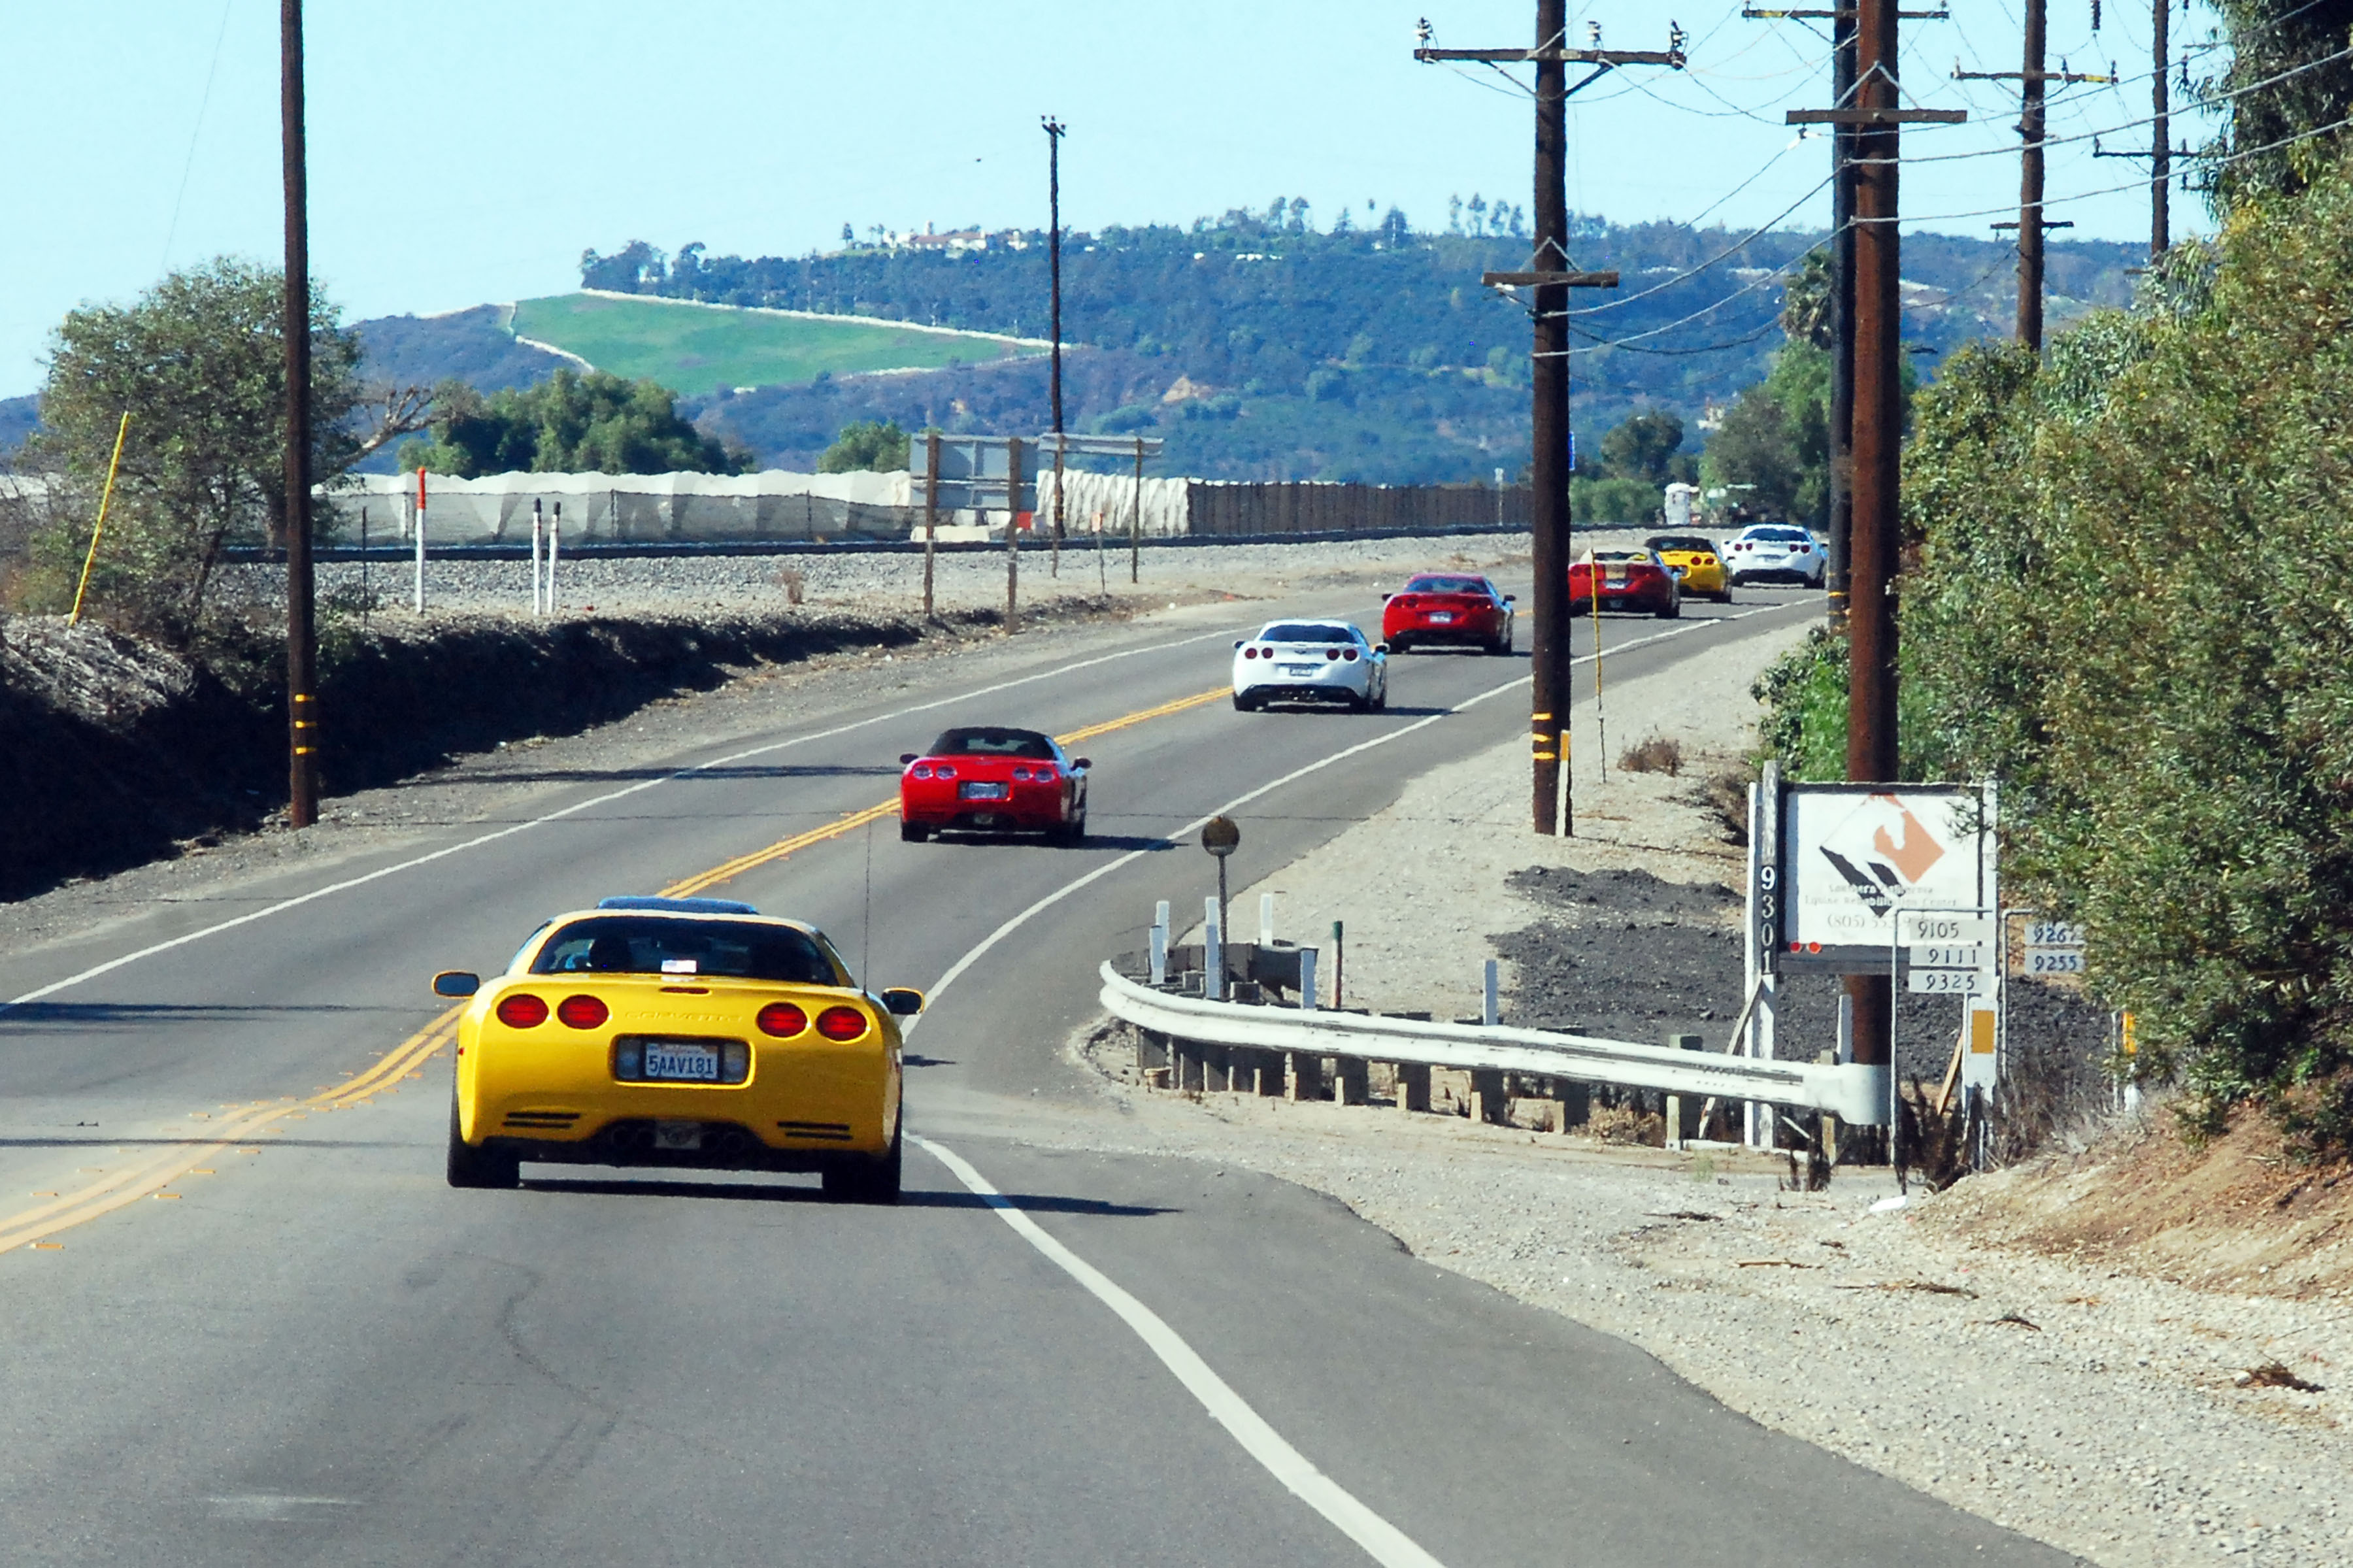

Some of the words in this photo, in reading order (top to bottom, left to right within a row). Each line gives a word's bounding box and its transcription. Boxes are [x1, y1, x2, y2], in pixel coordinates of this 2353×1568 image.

[1761, 866, 1775, 974] 9301
[1827, 914, 1865, 929] (805)
[1918, 921, 1959, 939] 9105
[1929, 948, 1976, 964] 9111
[2035, 955, 2077, 971] 9255
[1926, 974, 1975, 990] 9325
[648, 1055, 714, 1075] 5AAV181
